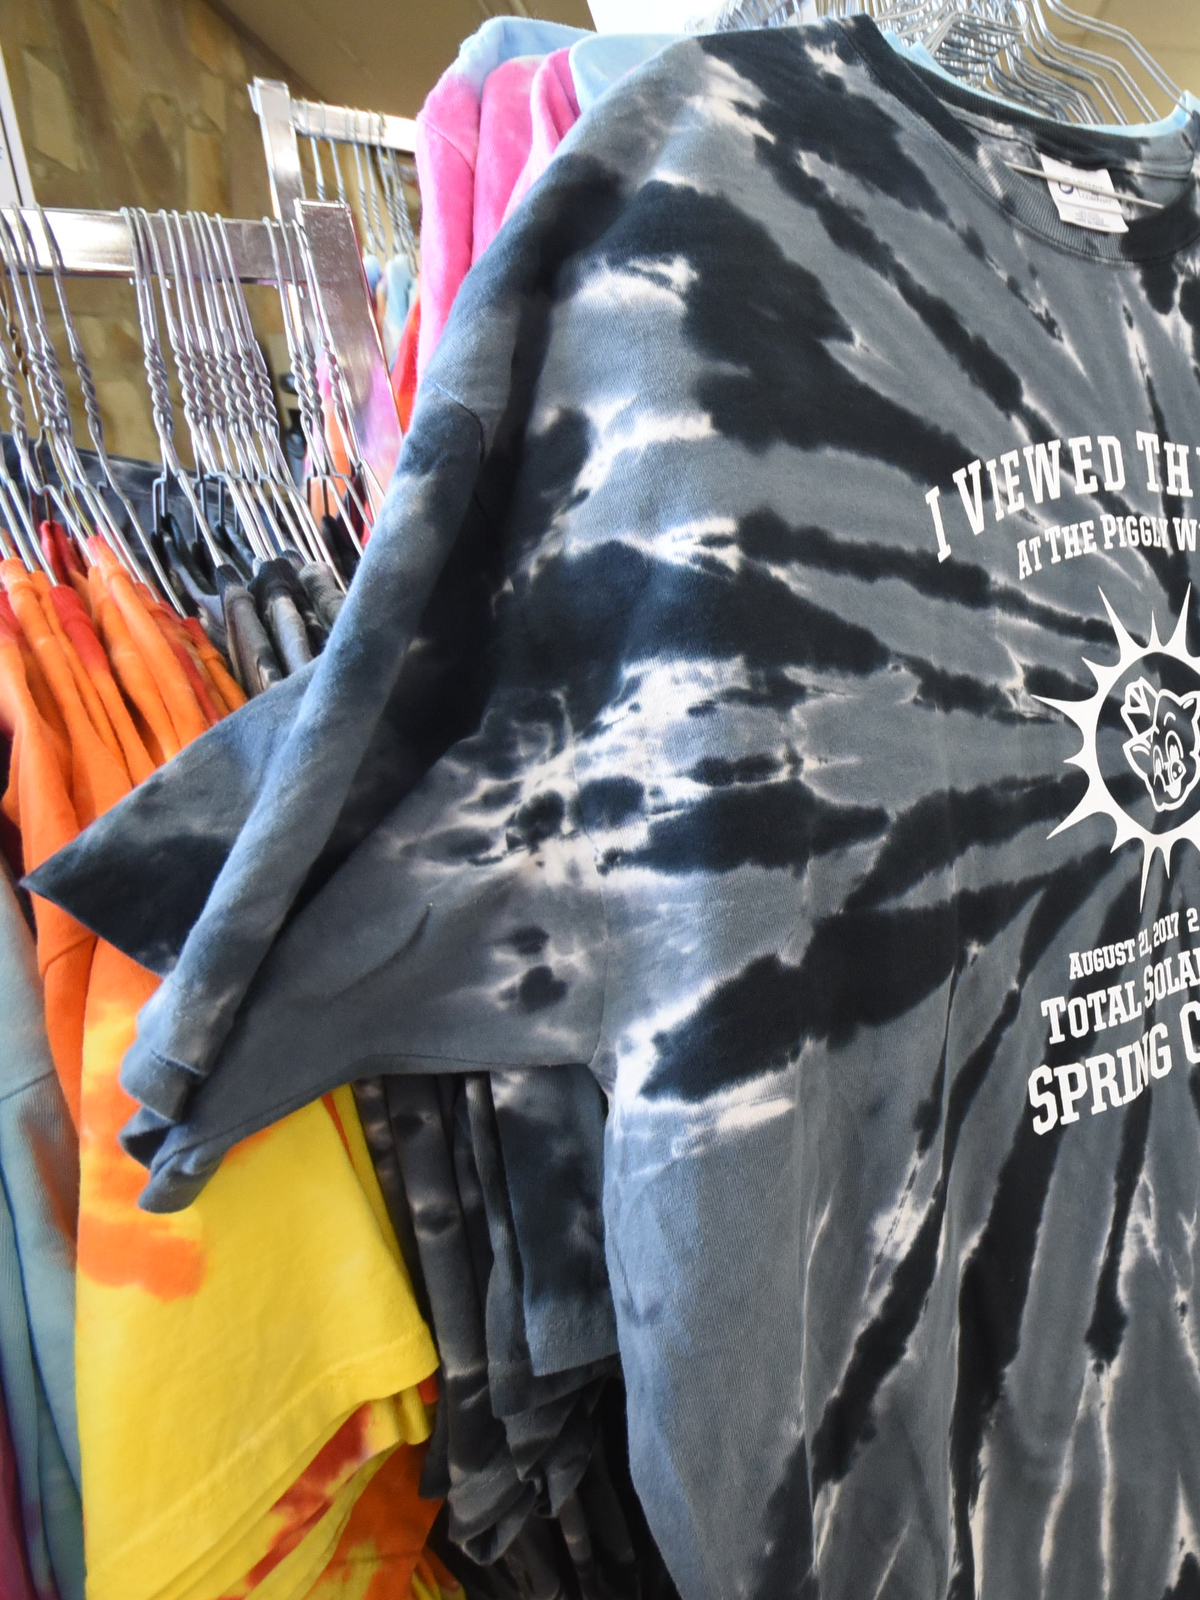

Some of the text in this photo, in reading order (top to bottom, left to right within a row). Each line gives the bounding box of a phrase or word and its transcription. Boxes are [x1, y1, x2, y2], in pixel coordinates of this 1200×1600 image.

[926, 486, 951, 562] I
[953, 435, 1125, 536] VIEWED
[1018, 540, 1042, 580] AT
[1045, 520, 1097, 564] THE
[1100, 514, 1168, 549] PIGGLY
[1069, 939, 1136, 980] AUGUST
[1153, 911, 1180, 948] 2017
[1041, 980, 1143, 1044] TOTAL
[1028, 1022, 1172, 1136] SPRING
